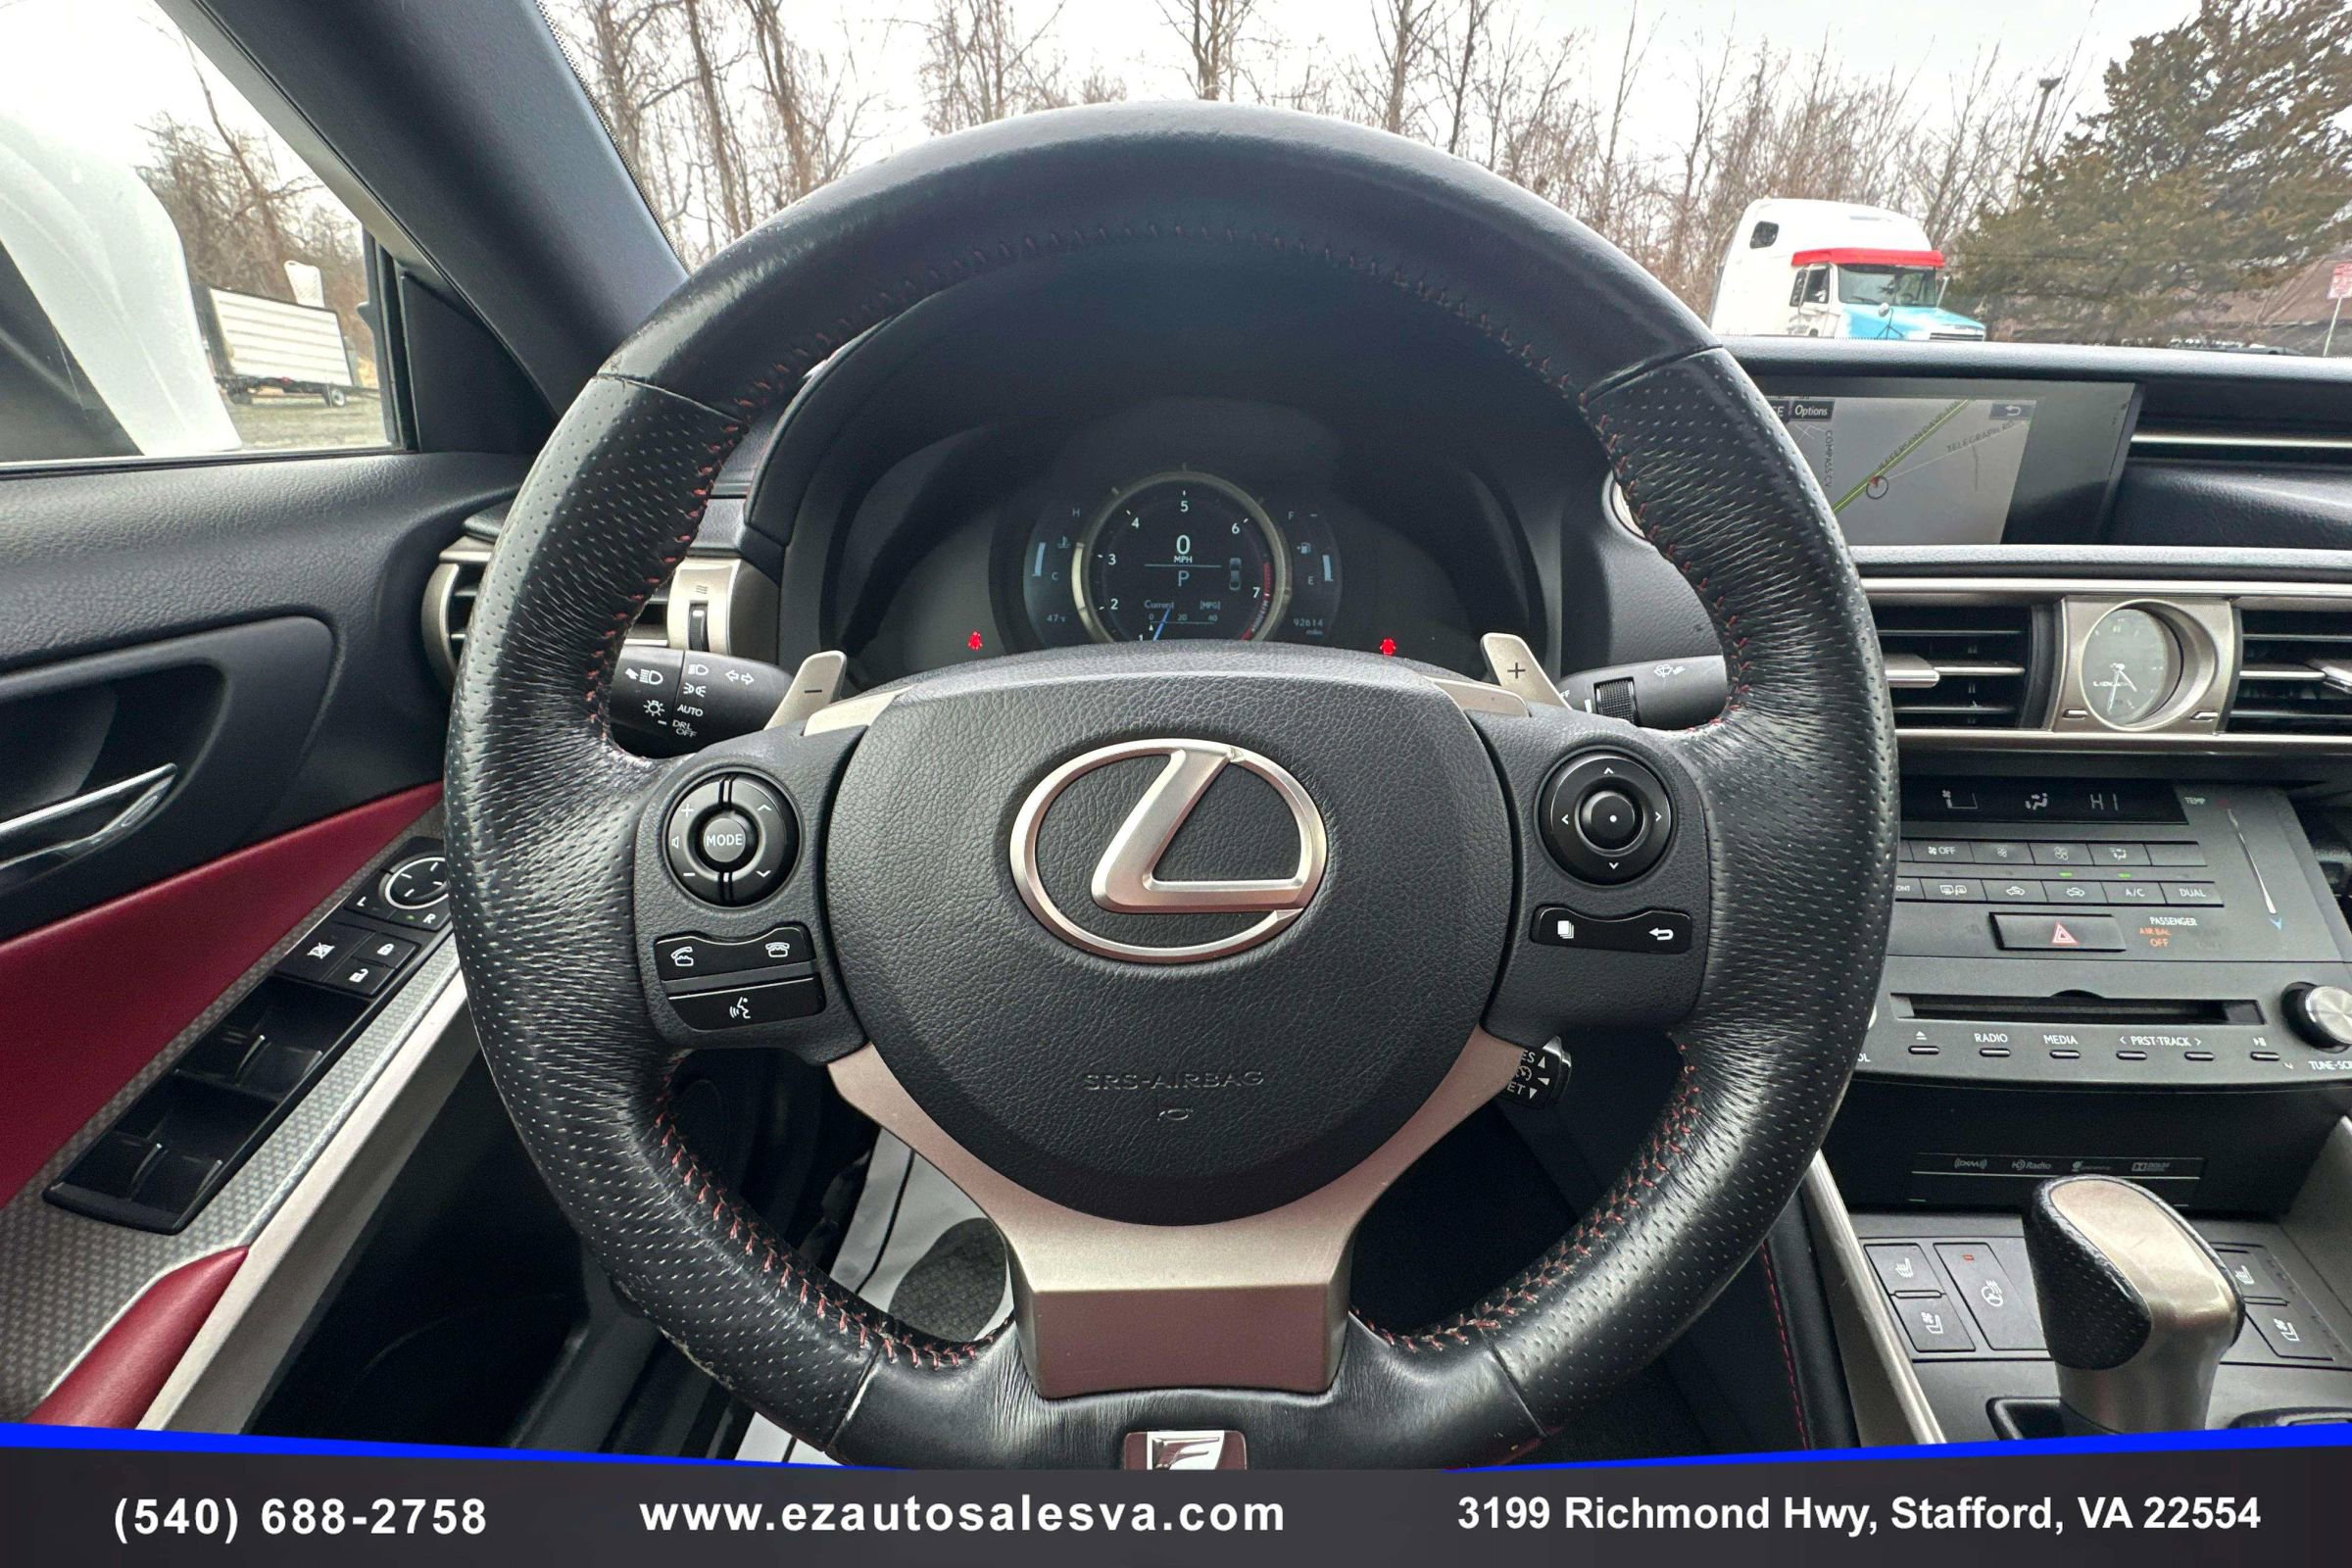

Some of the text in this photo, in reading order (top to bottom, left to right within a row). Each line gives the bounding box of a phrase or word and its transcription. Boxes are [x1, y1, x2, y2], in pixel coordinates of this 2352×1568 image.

[1794, 404, 1828, 417] Options
[1946, 427, 2000, 452] TELEGRAPH
[1825, 430, 1834, 473] COMPASS
[1180, 500, 1189, 513] 5
[1072, 508, 1081, 517] H
[1288, 511, 1294, 520] F
[1132, 516, 1140, 529] 4
[1231, 522, 1240, 535] 6
[1176, 534, 1191, 555] 0
[1107, 553, 1116, 565] 3
[1052, 571, 1058, 581] C
[1178, 569, 1190, 587] P
[1307, 575, 1314, 585] E
[1252, 586, 1260, 599] 7
[1110, 598, 1119, 610] 2
[1144, 599, 1174, 609] Current
[1294, 618, 1324, 627] 92614
[676, 704, 704, 716] AUTO
[671, 719, 691, 729] DRL
[675, 727, 698, 737] OFF
[2089, 793, 2119, 810] HI
[2183, 797, 2206, 806] TEMP
[706, 833, 743, 848] MODE
[1937, 846, 1956, 856] OFF
[2125, 888, 2146, 898] A/C
[2179, 888, 2207, 898] DUAL
[356, 896, 367, 907] L
[422, 912, 436, 924] R
[2149, 916, 2198, 926] PASSENGER
[2148, 937, 2170, 948] OFF
[1974, 1032, 2009, 1044] RADIO
[2043, 1034, 2079, 1045] MEDIA
[2026, 1161, 2053, 1170] Radio
